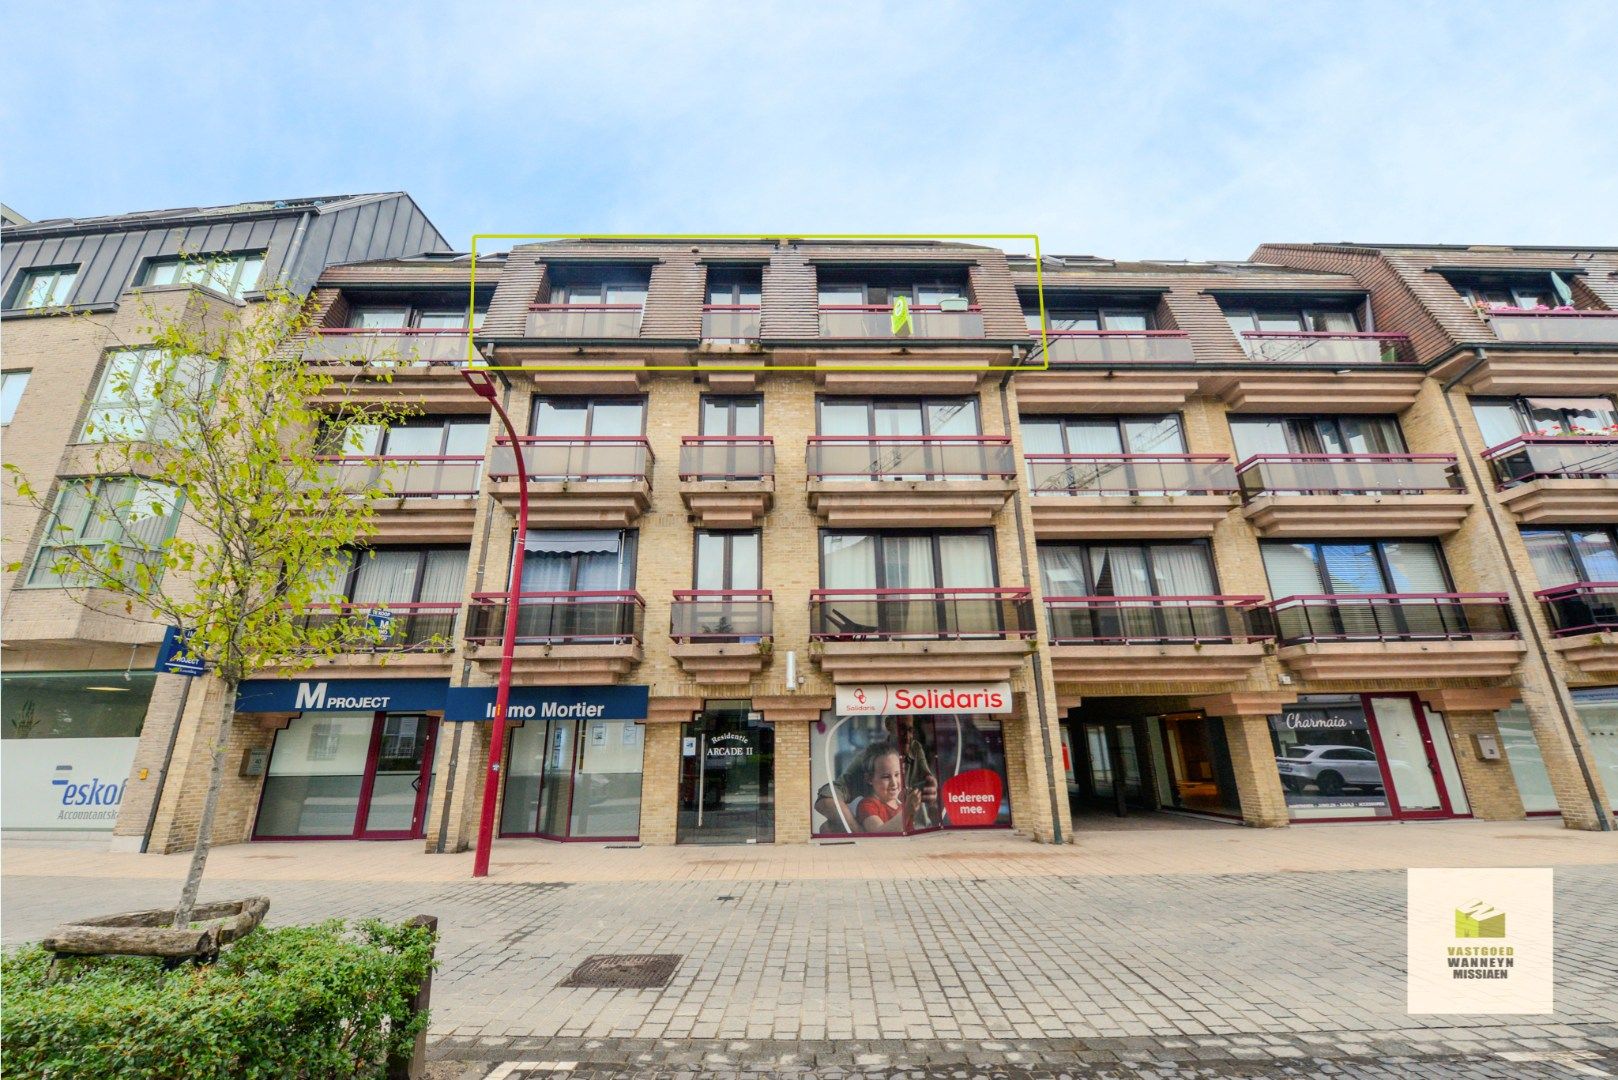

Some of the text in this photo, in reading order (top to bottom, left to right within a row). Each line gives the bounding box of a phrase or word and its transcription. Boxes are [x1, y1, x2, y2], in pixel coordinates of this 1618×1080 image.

[295, 682, 391, 709] M PROJECT
[895, 688, 1003, 709] Solidaris
[541, 701, 605, 718] Mortier
[1286, 713, 1348, 729] Charmaia
[711, 732, 749, 744] Residentie
[706, 747, 753, 756] ARCADE II
[948, 791, 995, 803] Iedereen
[960, 806, 986, 814] mee.
